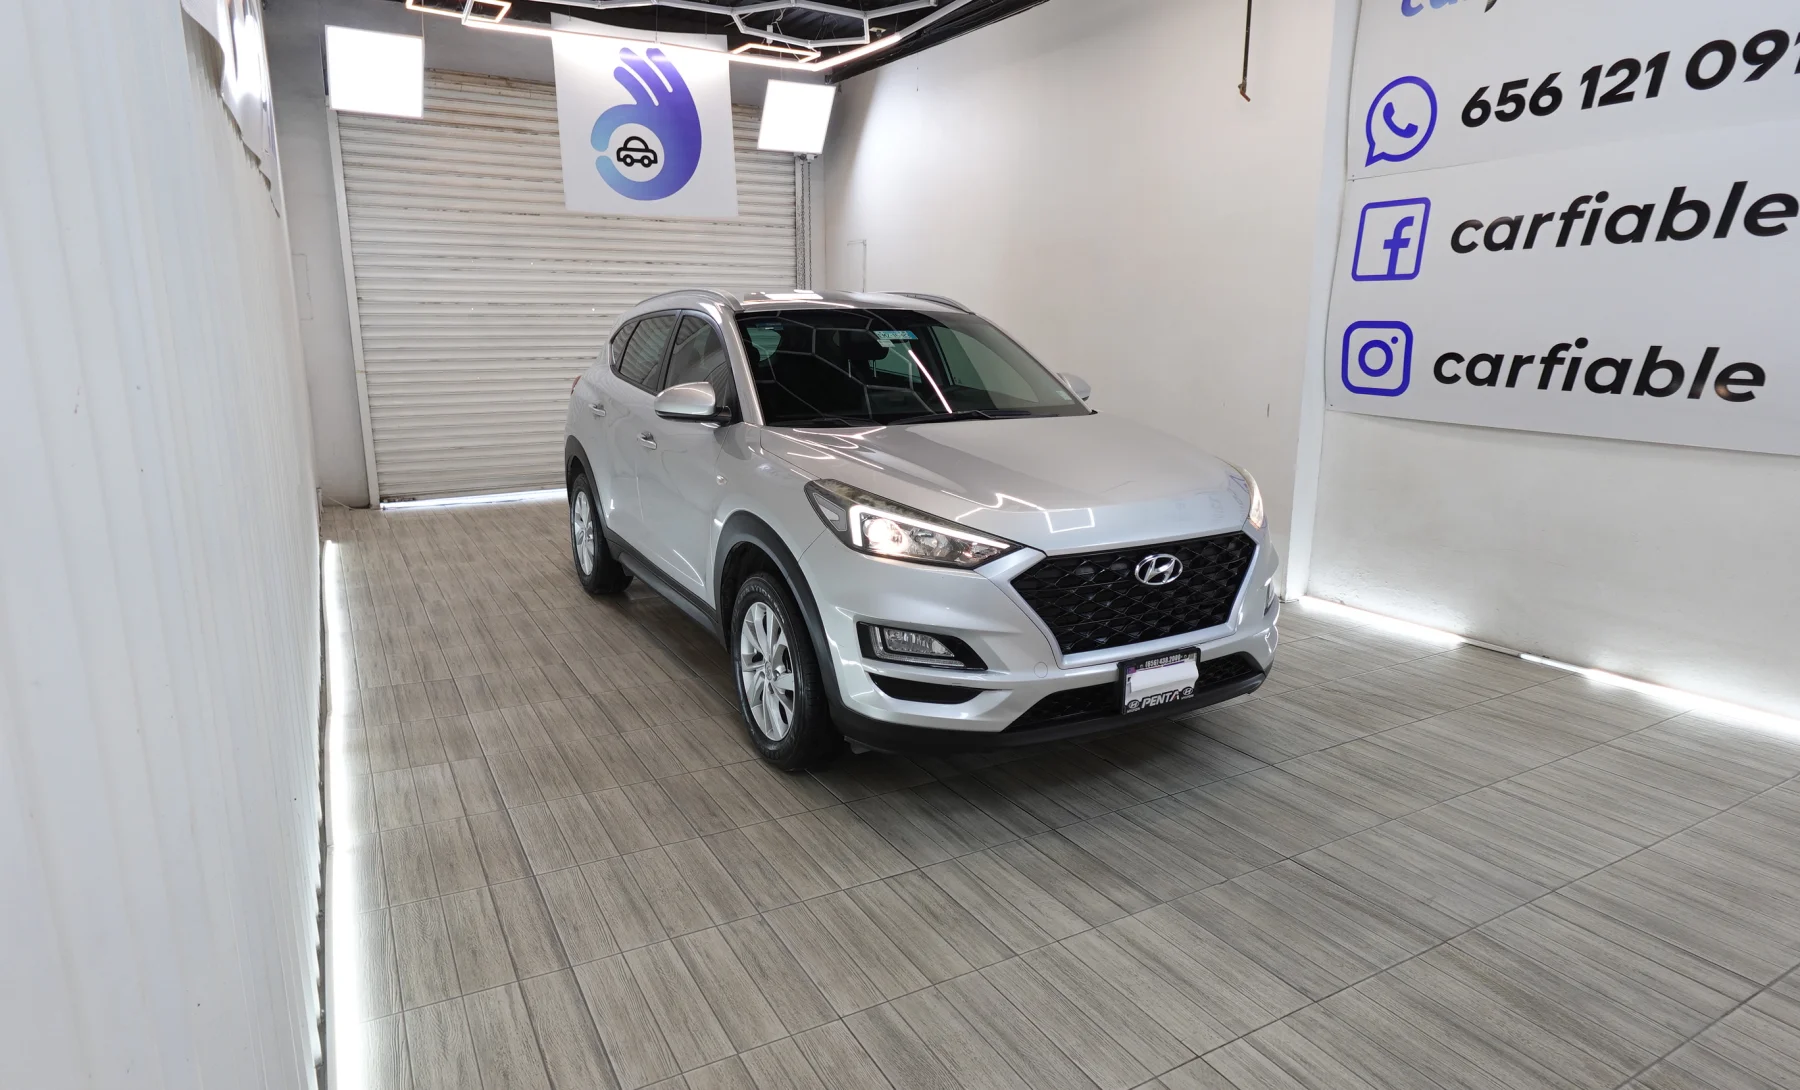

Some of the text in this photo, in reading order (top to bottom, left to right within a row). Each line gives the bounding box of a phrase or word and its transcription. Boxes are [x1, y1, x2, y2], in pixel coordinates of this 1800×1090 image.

[1461, 72, 1563, 128] 656
[1580, 51, 1671, 110] 121
[1450, 181, 1799, 254] carfiable
[1433, 337, 1766, 403] carfiable
[1141, 689, 1180, 709] PENTA
